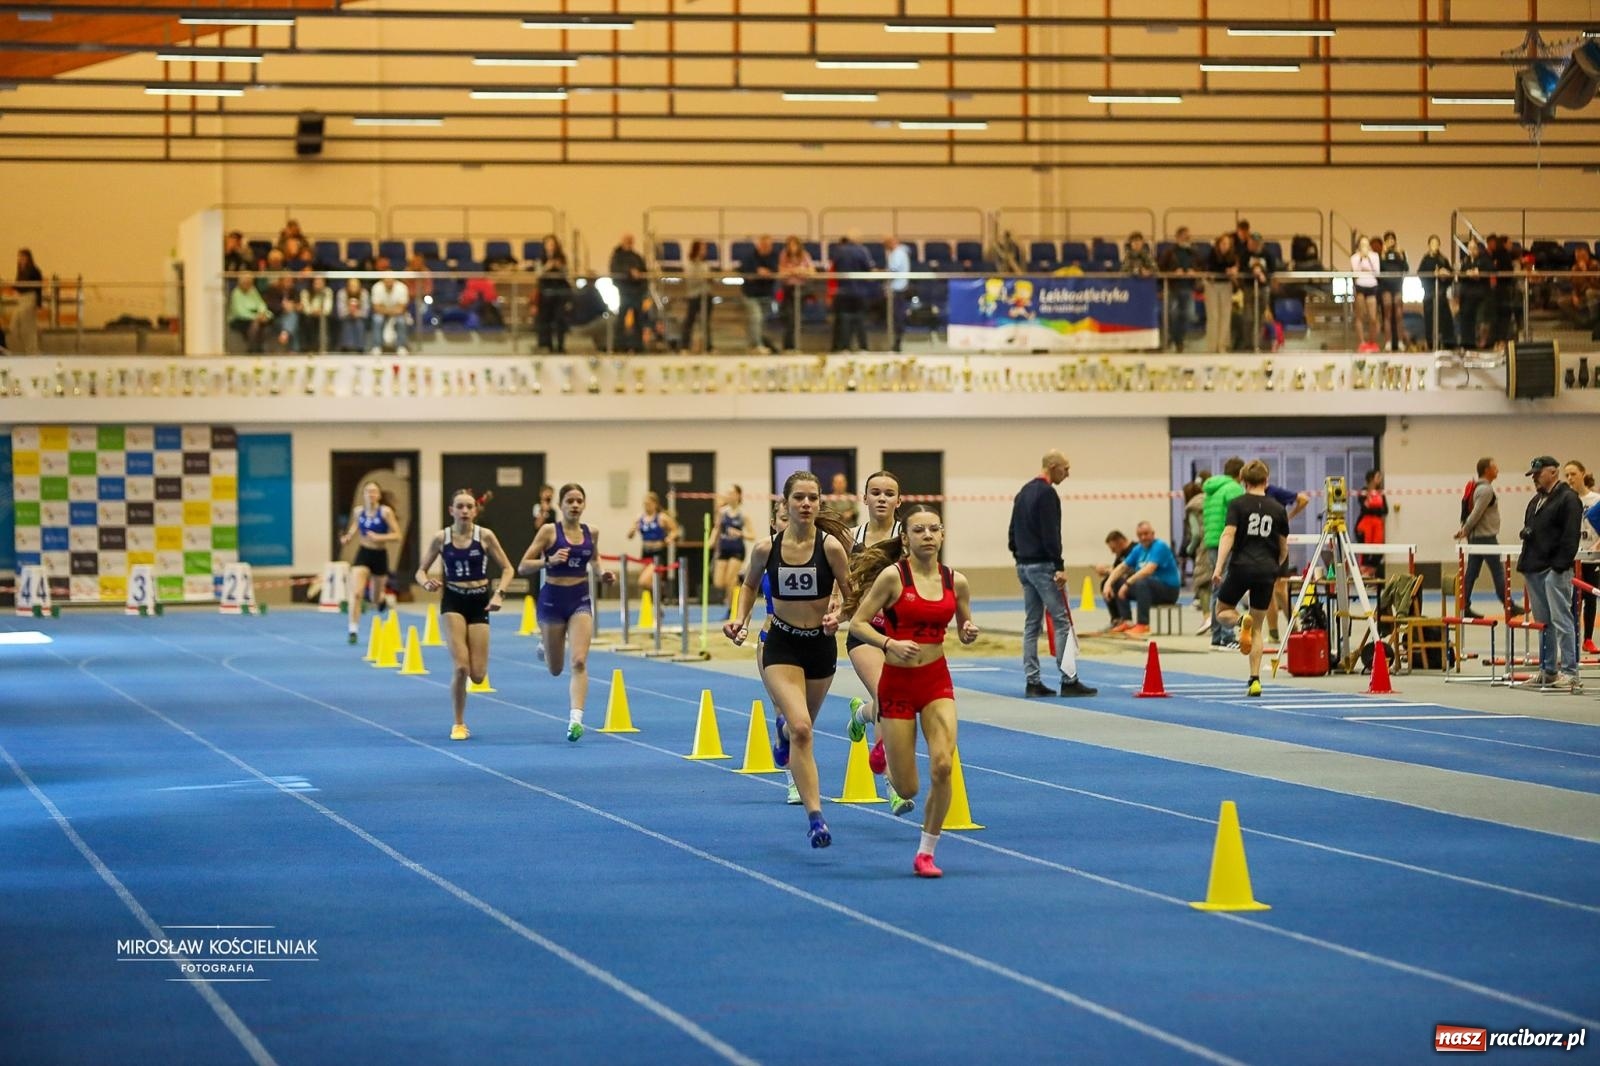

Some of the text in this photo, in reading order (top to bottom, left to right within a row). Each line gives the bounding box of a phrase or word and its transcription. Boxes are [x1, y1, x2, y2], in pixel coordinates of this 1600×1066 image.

[1247, 512, 1273, 538] 20
[22, 576, 31, 605] 4
[133, 575, 146, 602] 3
[227, 574, 238, 601] 2
[785, 573, 813, 591] 49
[792, 629, 820, 638] PRO
